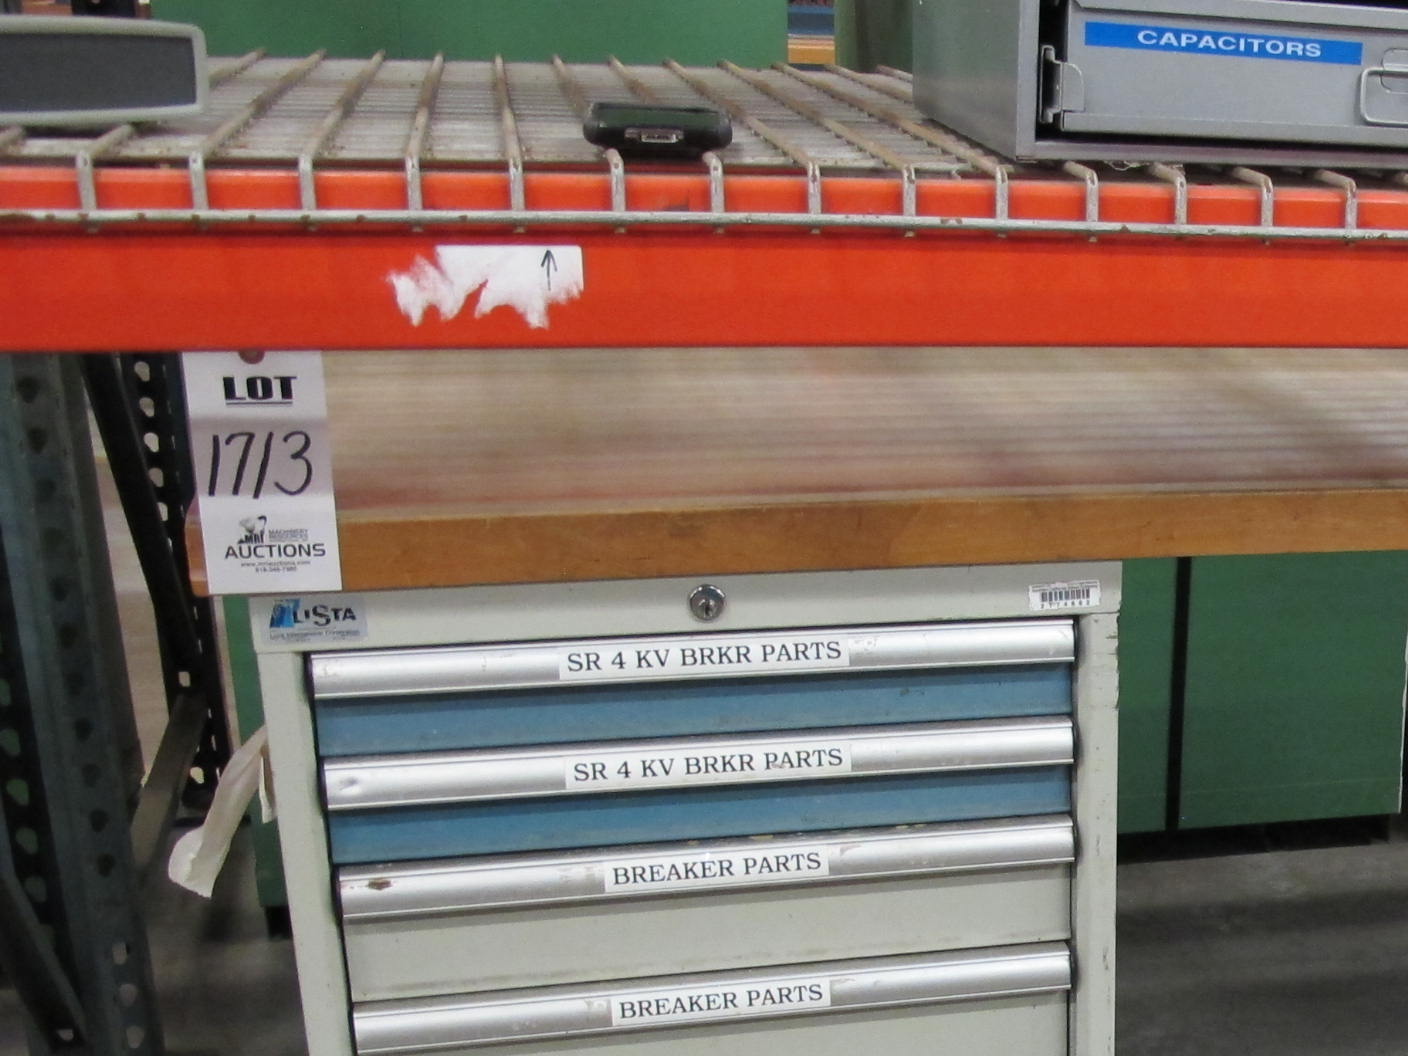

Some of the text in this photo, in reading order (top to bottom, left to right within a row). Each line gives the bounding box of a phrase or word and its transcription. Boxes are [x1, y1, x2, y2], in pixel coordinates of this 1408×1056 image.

[1137, 30, 1321, 57] CAPACITORS
[222, 376, 298, 401] LOT
[208, 430, 313, 499] 1713
[225, 543, 326, 559] AUCTIONS
[567, 641, 842, 672] SR 4 KV BRKR PARTS
[574, 748, 843, 782] SR 4 KV BRKR PARTS
[613, 852, 822, 886] BREAKER PARTS
[619, 984, 823, 1019] BREAKER PARTS
